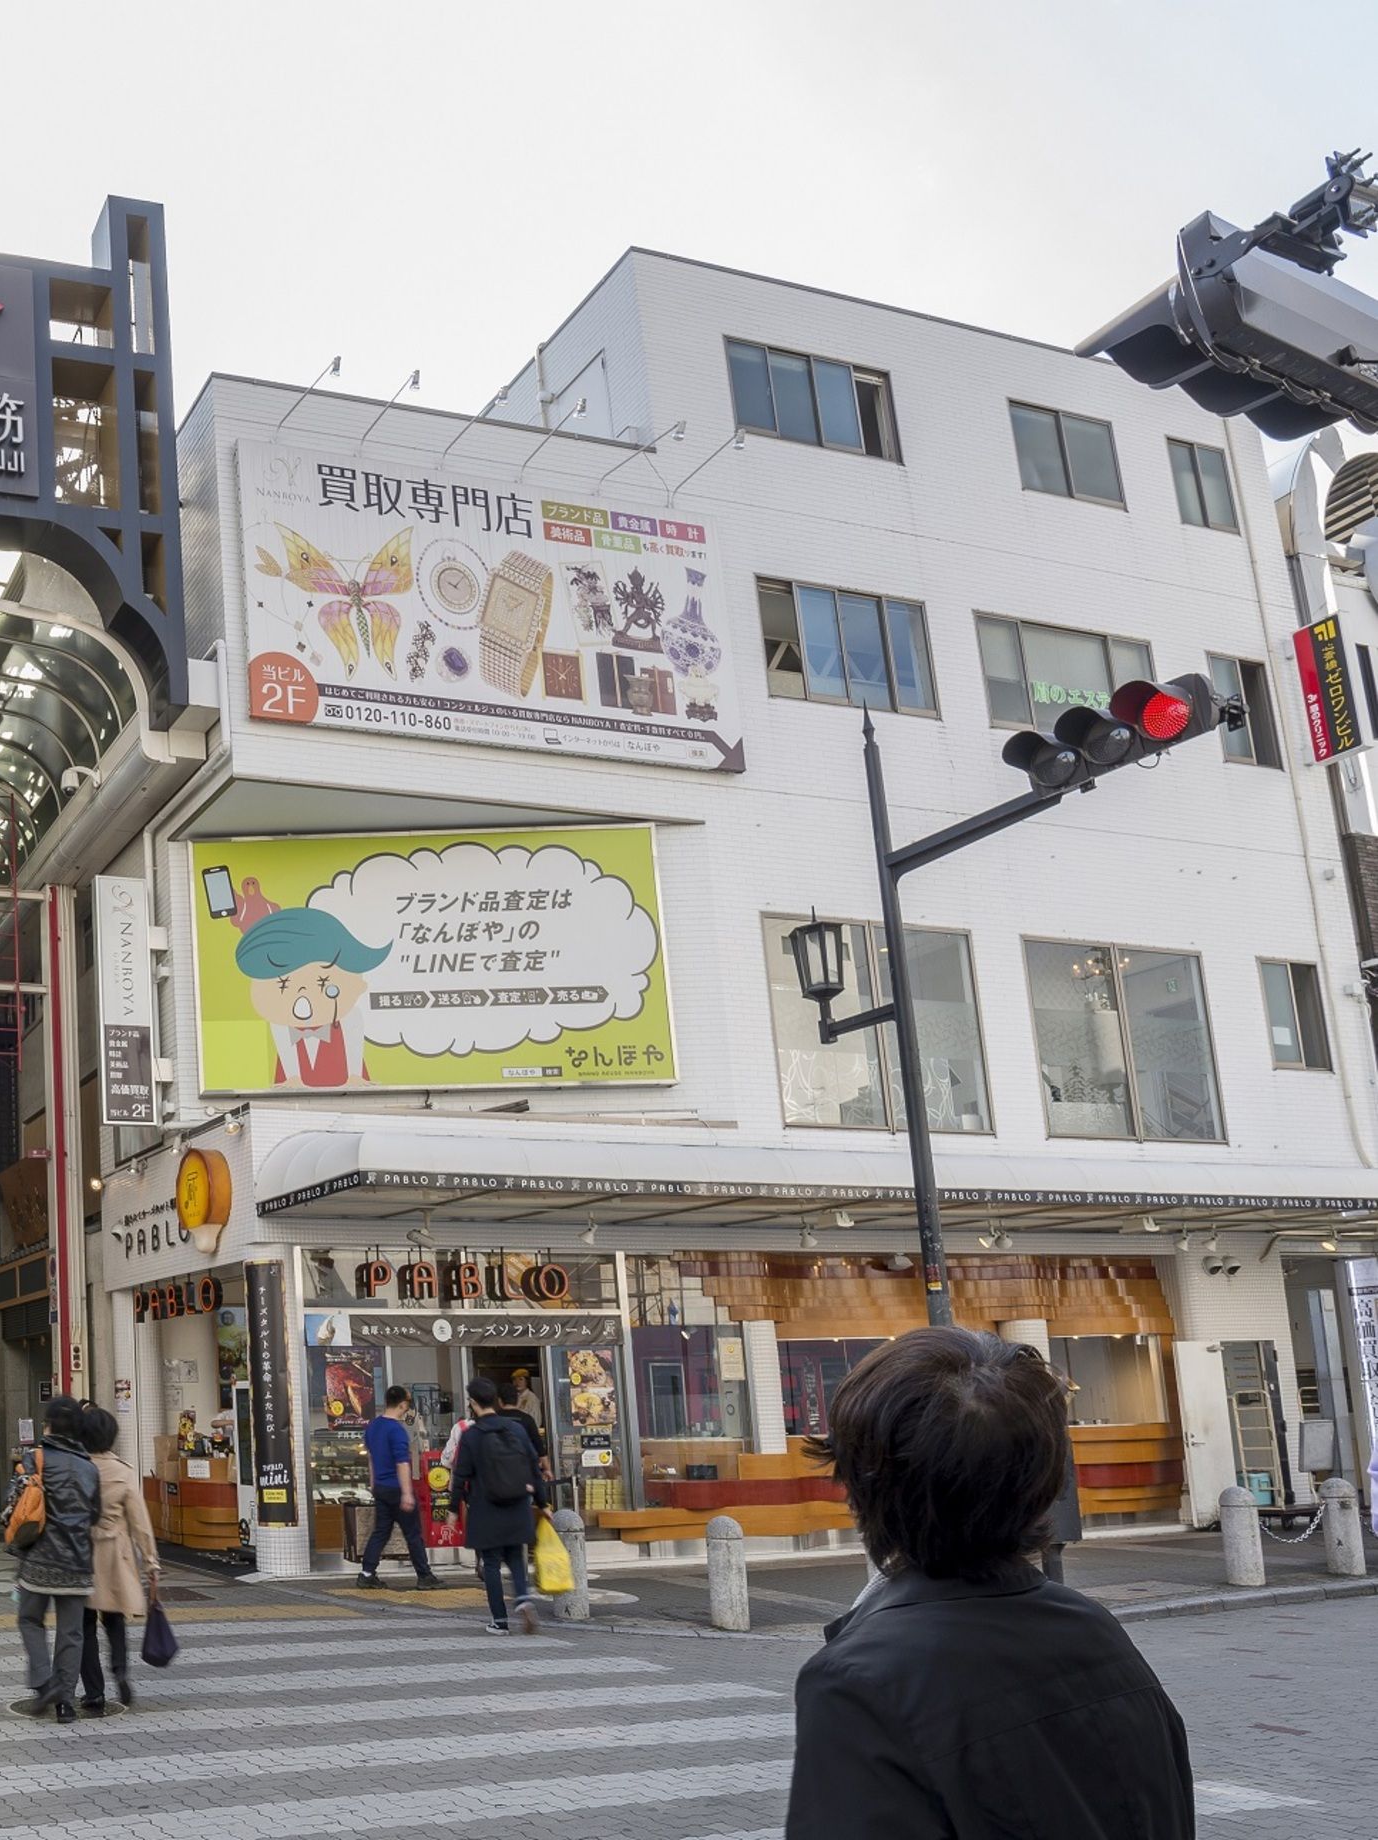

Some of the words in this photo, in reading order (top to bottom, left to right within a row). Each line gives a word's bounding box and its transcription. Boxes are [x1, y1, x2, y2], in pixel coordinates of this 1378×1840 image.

[316, 462, 533, 539] 買取専門店
[547, 505, 604, 525] ブランド品
[617, 515, 651, 533] 貴金属
[550, 526, 586, 543] 美術品
[262, 664, 306, 682] 当ビル
[261, 683, 307, 714] 2F
[346, 704, 452, 732] 0120-110-860
[395, 888, 572, 915] ブランド品査定は
[397, 919, 539, 945] 「なんぼや」の
[119, 920, 135, 1016] NANBOYA
[379, 995, 402, 1007] 撮る
[437, 993, 461, 1005] 送る
[497, 991, 521, 1003] 査定
[557, 990, 580, 1002] 売る
[565, 1044, 665, 1069] なんぼや
[111, 1084, 150, 1096] 高価買取
[131, 1103, 151, 1119] 2F
[297, 1187, 321, 1201] PABLO
[333, 1174, 359, 1191] PABLO
[384, 1174, 429, 1185] PABLO
[453, 1176, 497, 1187] PABLO
[521, 1178, 564, 1190] PABLO
[587, 1181, 629, 1192] PABLO
[651, 1184, 691, 1193] PABLO
[714, 1185, 753, 1195] PABLO
[774, 1187, 812, 1196] PABLO
[832, 1189, 870, 1198] PABLO
[889, 1190, 916, 1199] PABL
[944, 1191, 979, 1200] PABLO
[997, 1193, 1031, 1202] PABLO
[1048, 1194, 1081, 1203] PABLO
[1098, 1195, 1130, 1204] PABLO
[1146, 1196, 1178, 1205] PABLO
[371, 1260, 569, 1300] PABLO
[134, 1275, 218, 1322] PABLO
[457, 1322, 592, 1338] チーズソフトクリーム
[259, 1470, 290, 1487] mini
